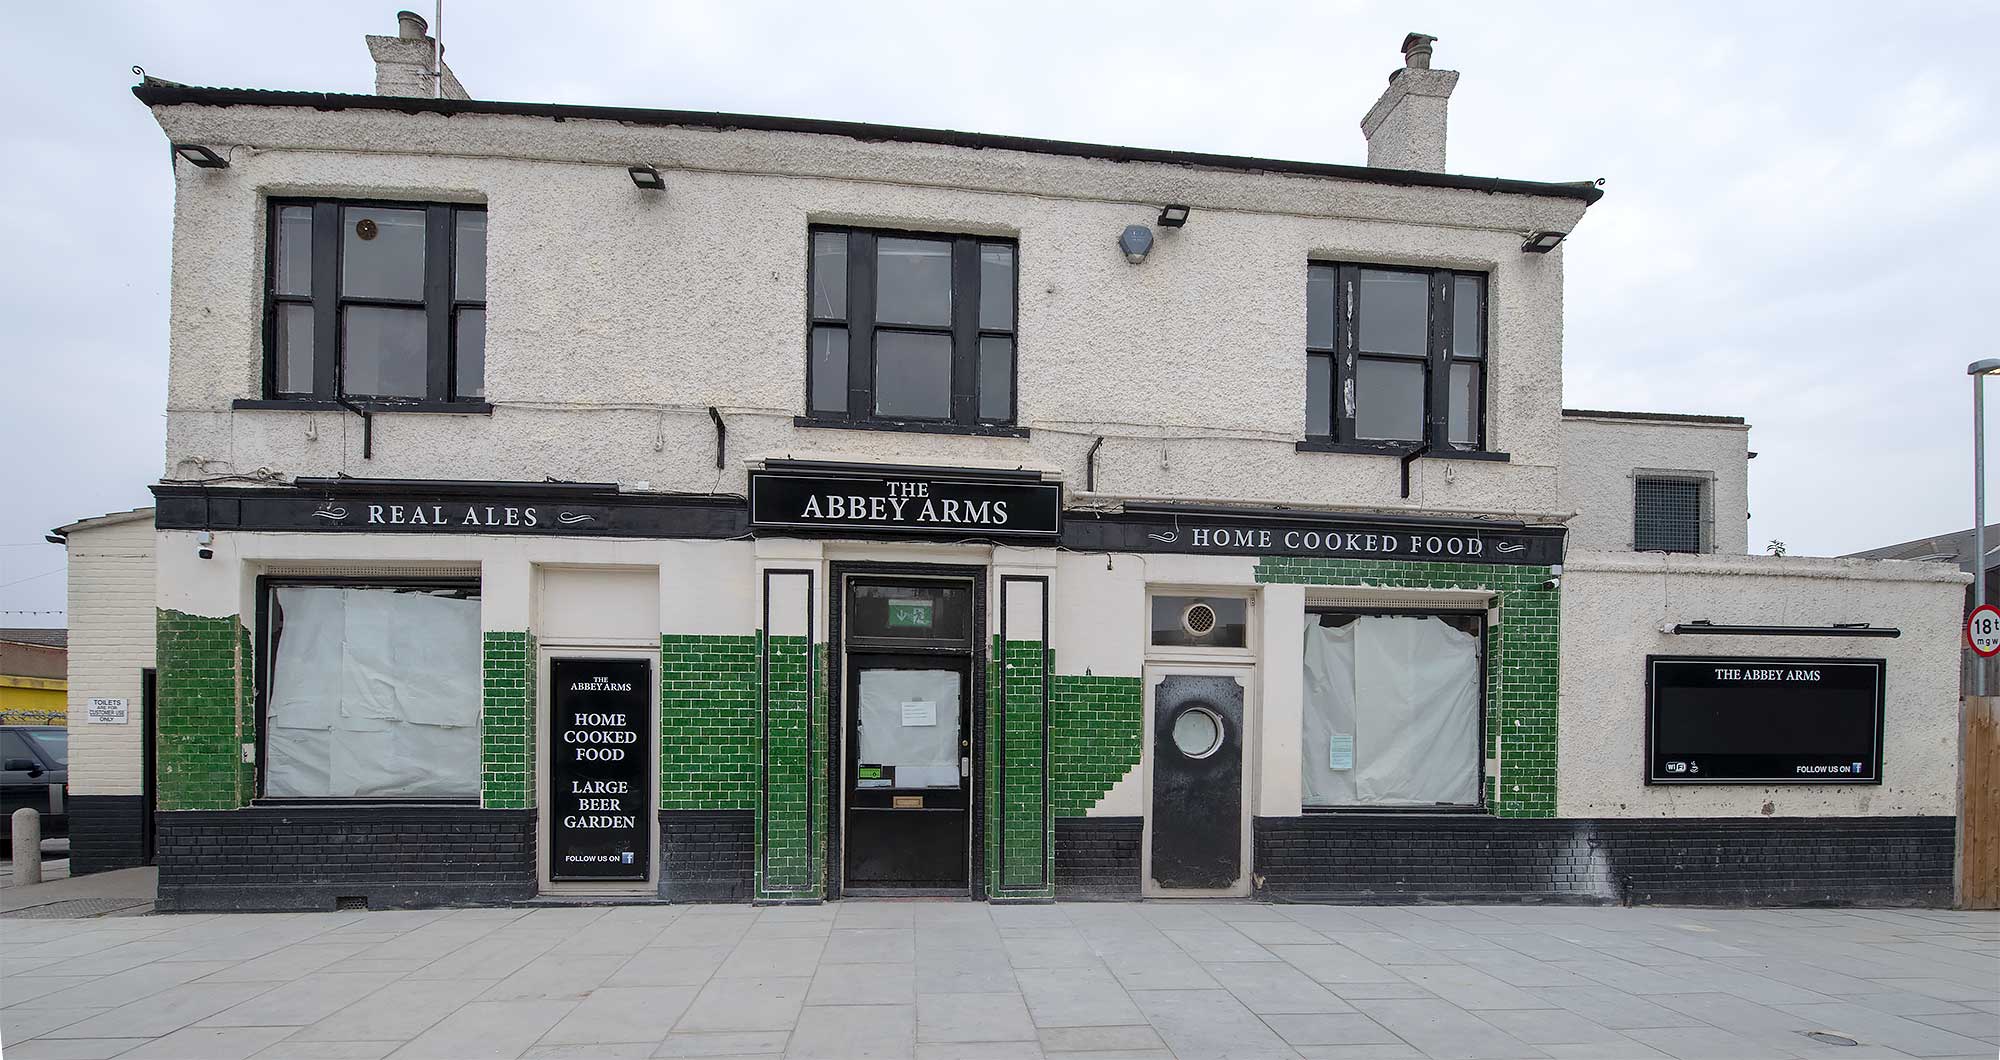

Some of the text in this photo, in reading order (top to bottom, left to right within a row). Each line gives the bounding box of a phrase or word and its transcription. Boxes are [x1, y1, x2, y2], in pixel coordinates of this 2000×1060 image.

[887, 482, 928, 497] THE
[801, 494, 1007, 524] ABBEY ARMS
[368, 506, 536, 526] REAL ALES
[1192, 529, 1483, 555] HOME COOKED FOOD
[1975, 619, 2000, 634] 18t
[1977, 638, 1999, 646] mgw
[1715, 669, 1820, 681] THE ABBEY ARMS
[571, 683, 632, 691] ABBEY ARMS
[575, 714, 626, 726] HOME
[564, 731, 636, 743] COOKED
[576, 748, 624, 760] FOOD
[572, 781, 628, 793] LARGE
[579, 799, 621, 810] BEER
[564, 816, 635, 828] GARDEN
